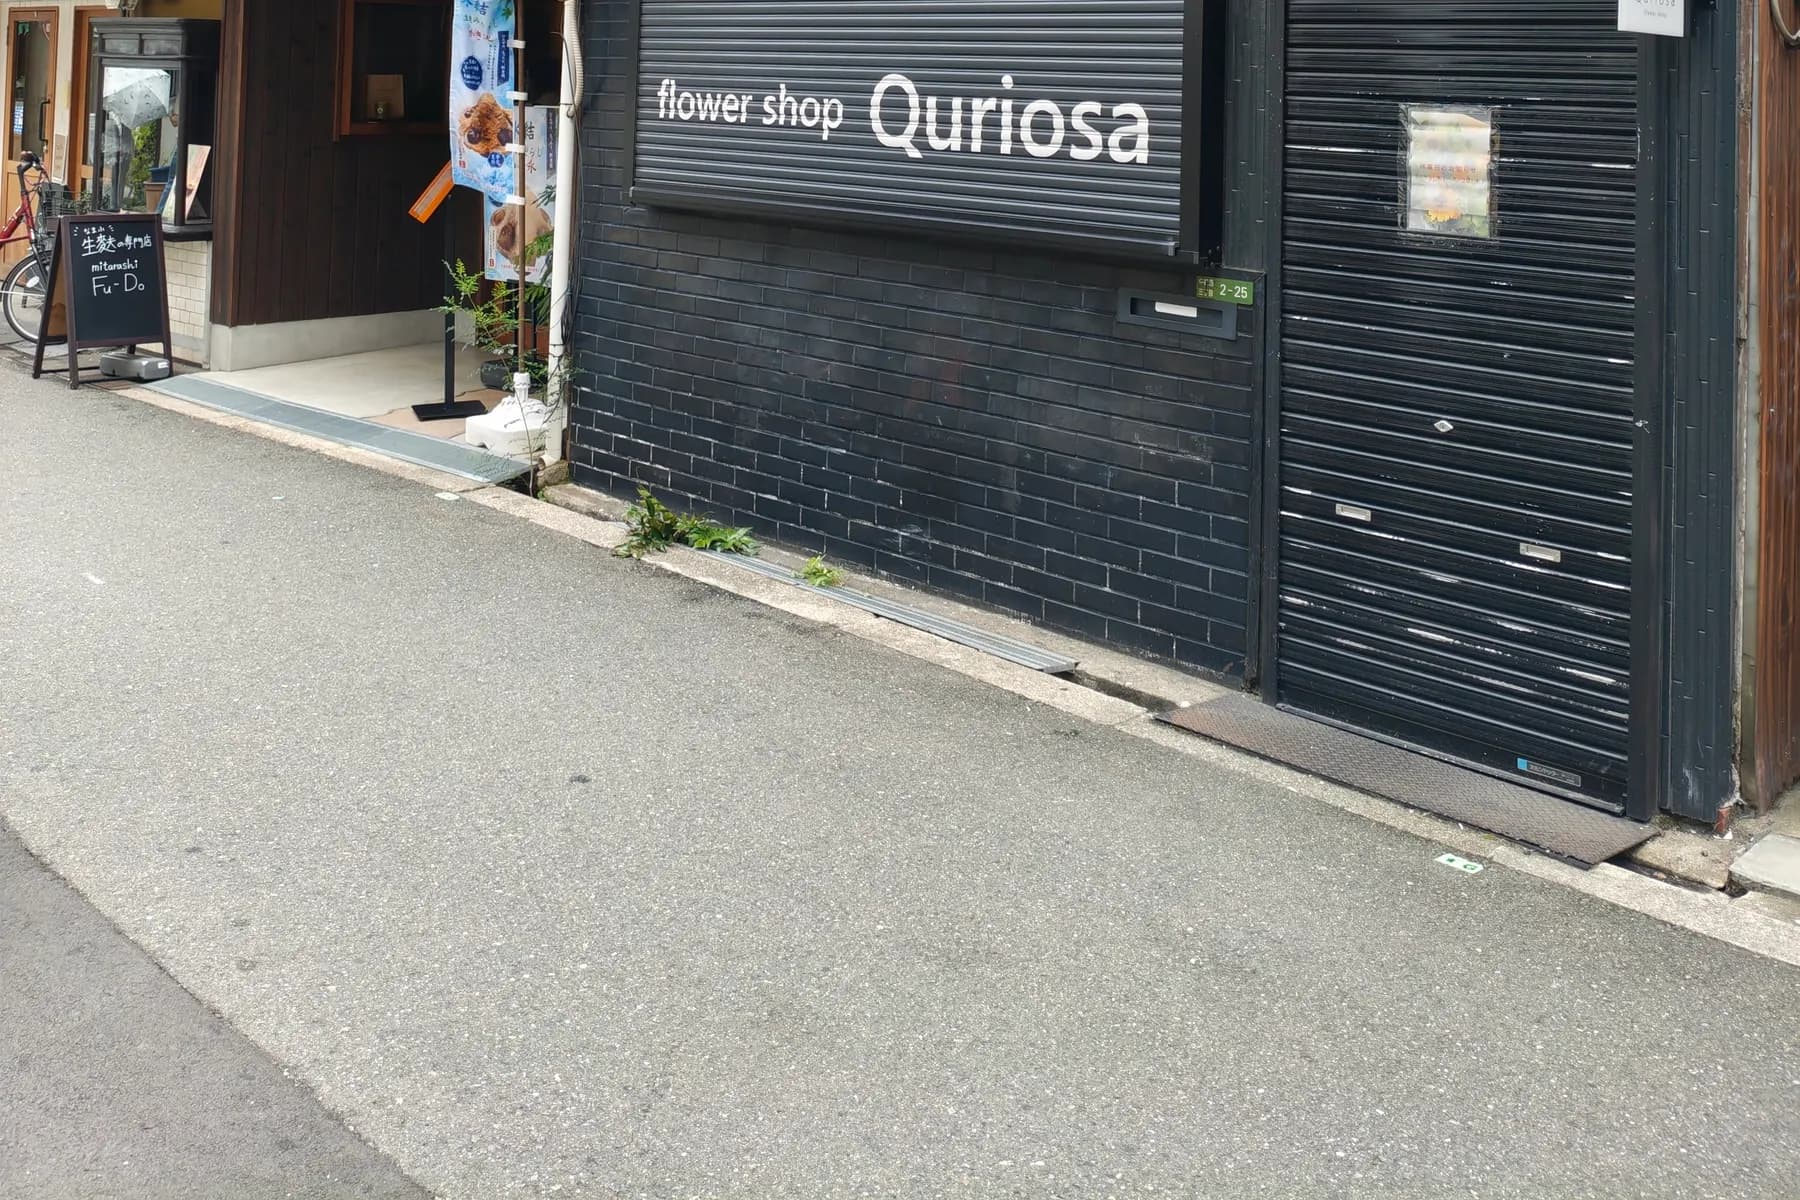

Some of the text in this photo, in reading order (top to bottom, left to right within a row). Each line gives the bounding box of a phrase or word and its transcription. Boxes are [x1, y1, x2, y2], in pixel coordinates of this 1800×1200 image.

[657, 78, 844, 141] flower shop
[869, 73, 1149, 165] Quriosa
[91, 258, 139, 273] mitarashi
[92, 272, 145, 297] Fu-Do
[1219, 284, 1248, 299] 2-25
